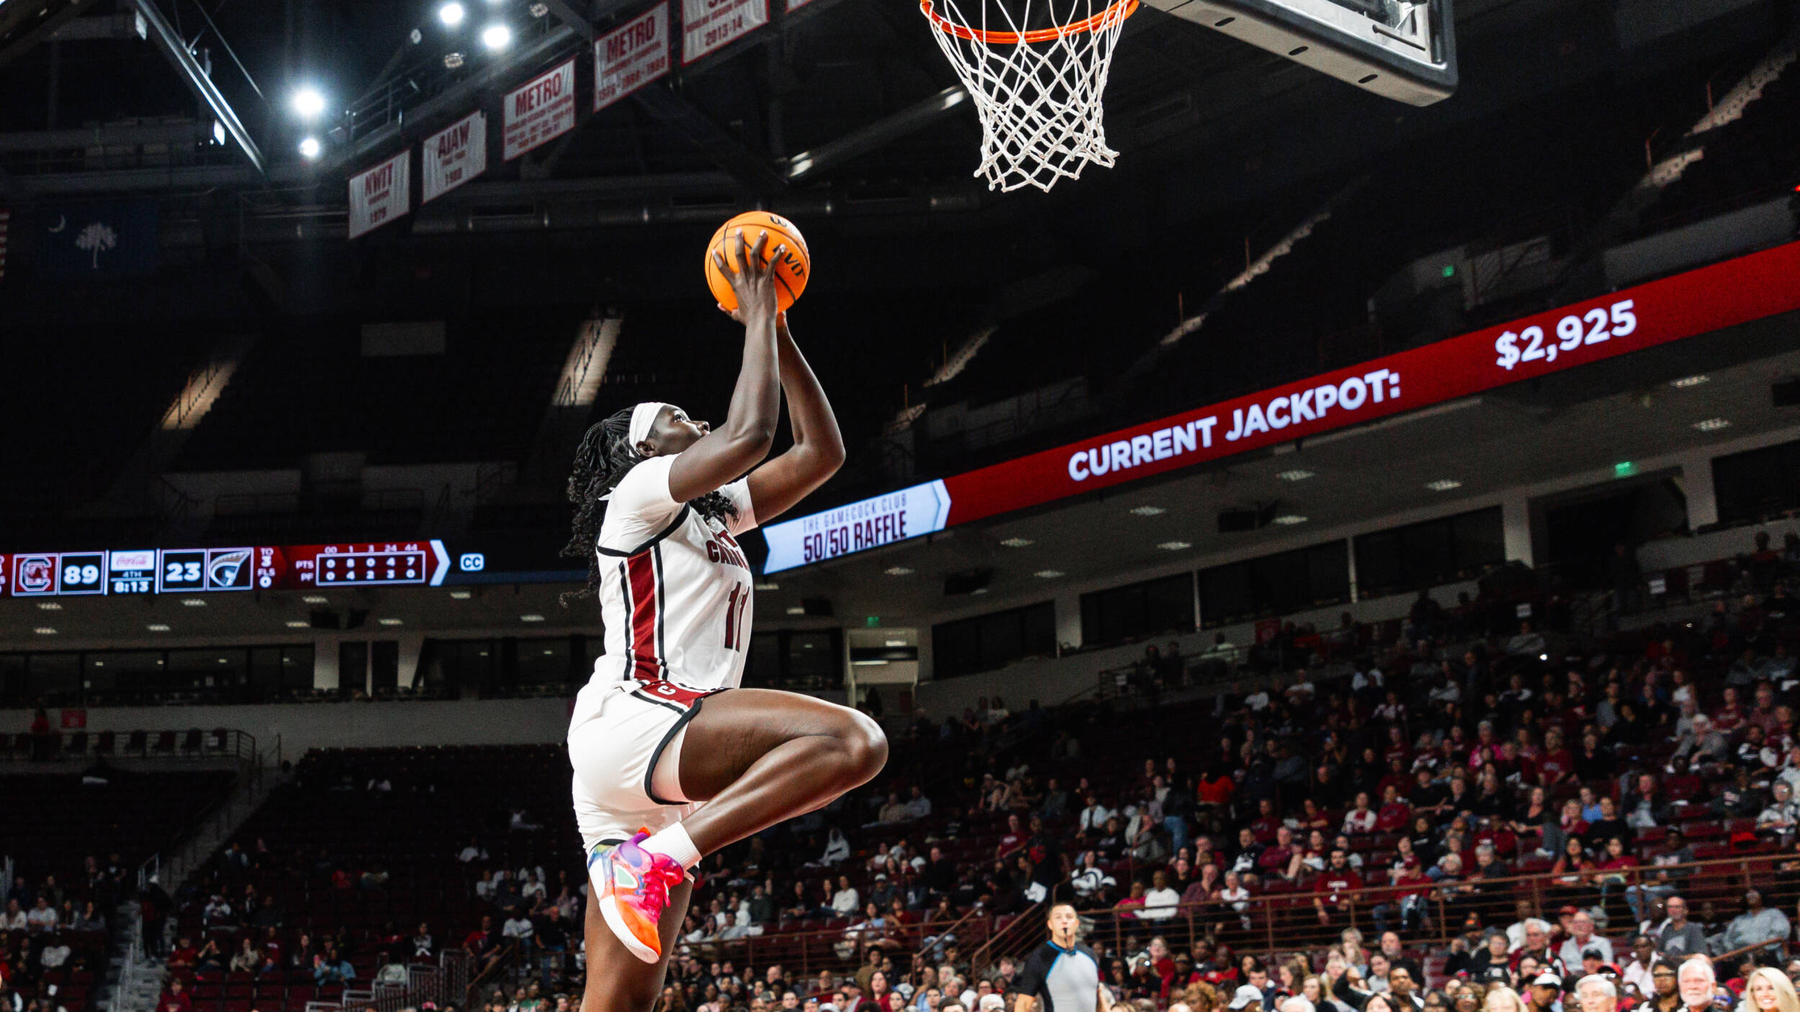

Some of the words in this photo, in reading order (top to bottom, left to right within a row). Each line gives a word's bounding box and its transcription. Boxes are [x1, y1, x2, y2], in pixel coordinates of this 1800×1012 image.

[607, 15, 655, 63] METRO
[516, 73, 562, 117] METRO
[438, 121, 470, 159] AIAW
[1495, 299, 1637, 370] $2,925
[1068, 416, 1217, 481] CURRENT
[1225, 369, 1400, 442] JACKPOT:
[803, 520, 820, 533] THE
[824, 506, 876, 527] GAMECOCK
[881, 493, 907, 513] CLUB
[803, 526, 850, 562] 50/50
[854, 511, 907, 551] RAFFLE
[260, 547, 274, 556] TO
[404, 543, 418, 552] 44
[295, 560, 314, 569] PTS
[326, 559, 336, 569] 0
[366, 557, 376, 567] 0
[386, 557, 396, 567] 4
[406, 556, 415, 566] 7
[463, 556, 482, 567] CC
[63, 565, 99, 585] 89
[165, 562, 201, 582] 23
[257, 568, 276, 577] FLS
[260, 576, 272, 588] 0
[300, 572, 314, 581] PF
[326, 571, 336, 581] 0
[346, 570, 355, 580] 4
[366, 570, 375, 580] 2
[406, 569, 416, 579] 0
[114, 581, 149, 593] 8:13
[719, 581, 751, 653] 11
